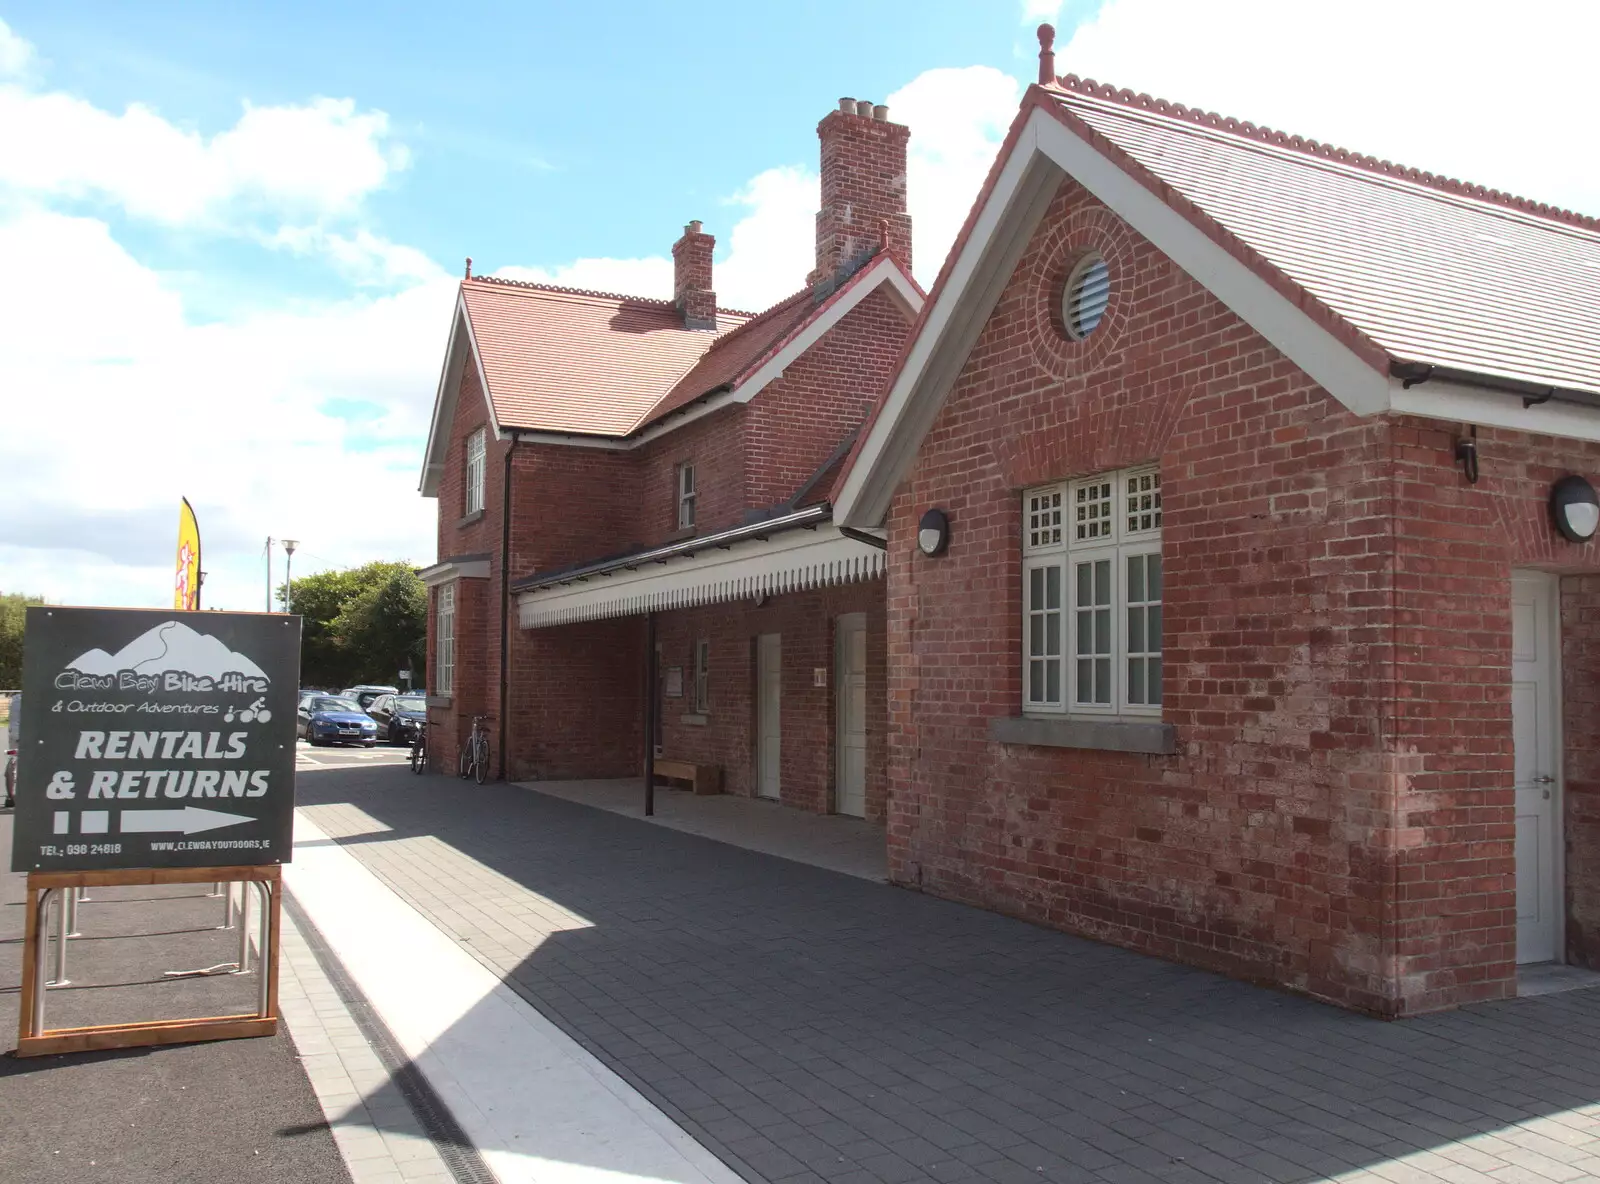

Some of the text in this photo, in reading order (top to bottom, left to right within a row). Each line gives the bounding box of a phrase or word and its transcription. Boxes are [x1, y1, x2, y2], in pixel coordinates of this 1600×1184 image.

[54, 672, 268, 694] Clew Bay Bike Hire
[52, 700, 219, 714] & Outdoor Adventures
[74, 730, 248, 759] RENTALS
[46, 770, 270, 799] & RETURNS
[67, 844, 87, 855] 098
